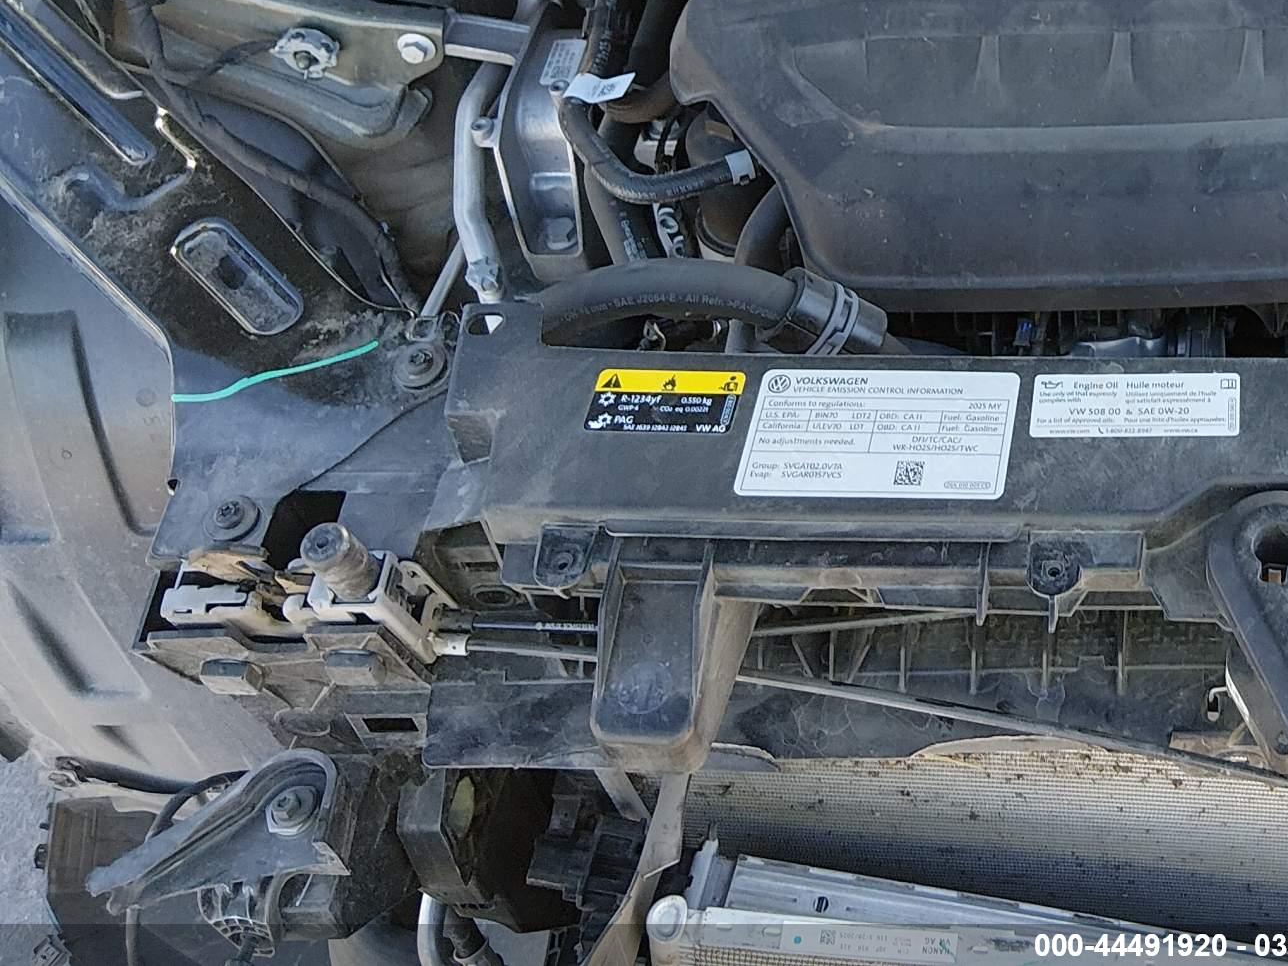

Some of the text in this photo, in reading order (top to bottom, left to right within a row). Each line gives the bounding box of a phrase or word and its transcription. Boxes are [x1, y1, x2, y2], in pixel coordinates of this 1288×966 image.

[794, 377, 869, 385] VOLKSWAGEN
[1126, 381, 1185, 389] Huile moteur
[793, 385, 965, 395] VEHICLE EMISSION CONTROL INFORMATION
[1073, 381, 1118, 391] Engine Oil
[620, 394, 712, 406] R-1234yf 0.550 kg
[768, 399, 807, 407] Conforms
[808, 399, 817, 407] to
[968, 402, 988, 410] 2025
[1138, 407, 1156, 415] SAE
[1157, 407, 1190, 415] 0W-20
[614, 415, 634, 424] PAG
[851, 412, 872, 420] LDT2
[695, 424, 711, 432] VW
[712, 424, 726, 432] AG
[964, 424, 998, 432] Gasoline
[758, 436, 856, 447] No adjustments needed.
